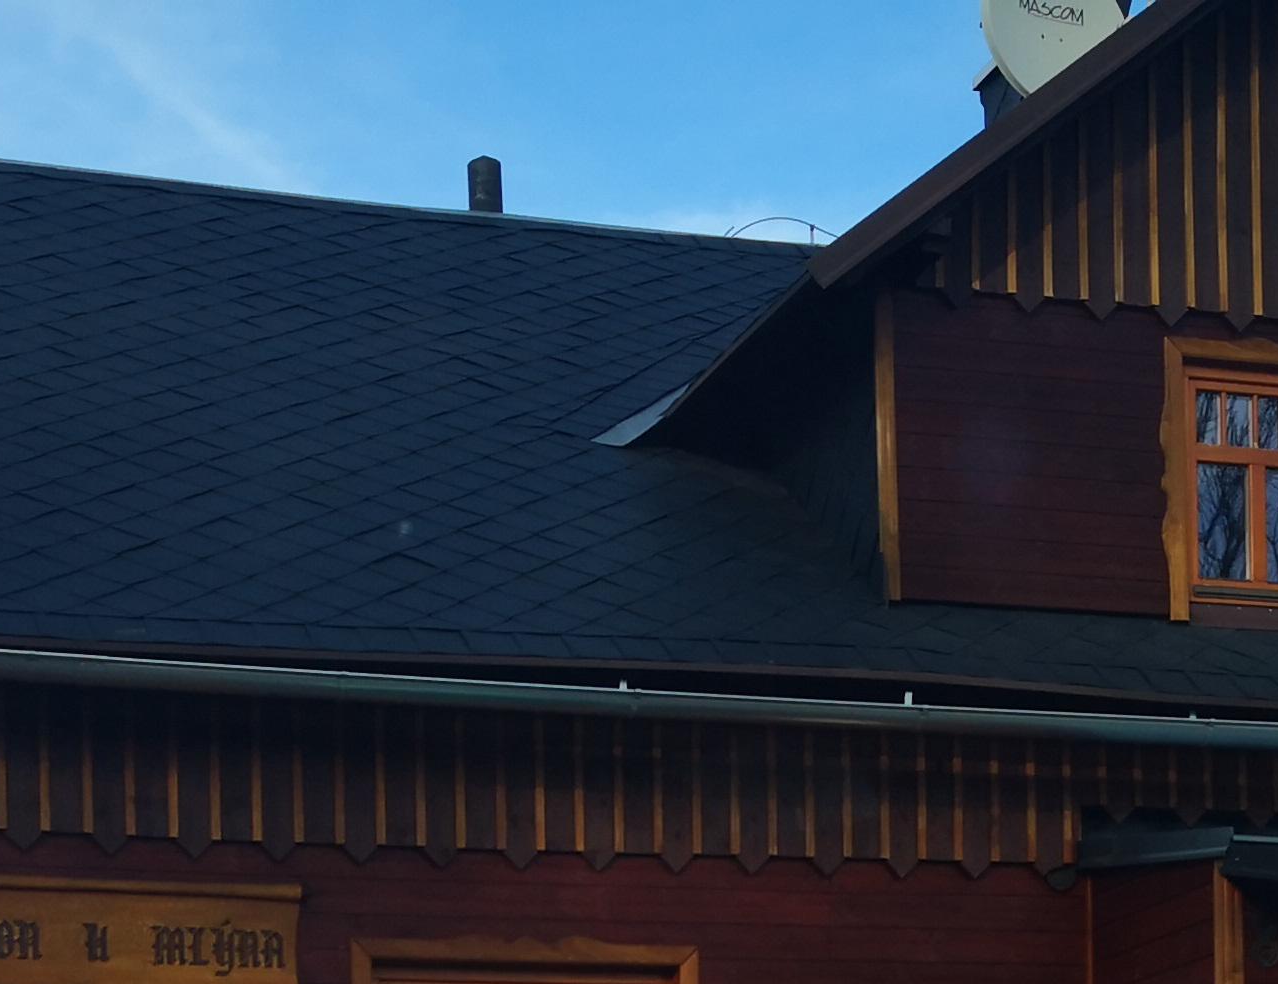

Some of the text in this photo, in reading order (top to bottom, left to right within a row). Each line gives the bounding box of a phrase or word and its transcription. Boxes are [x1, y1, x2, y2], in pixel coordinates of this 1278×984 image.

[1019, 0, 1084, 26] MASCOM
[82, 922, 109, 963] U
[150, 919, 286, 977] MLÝNA
